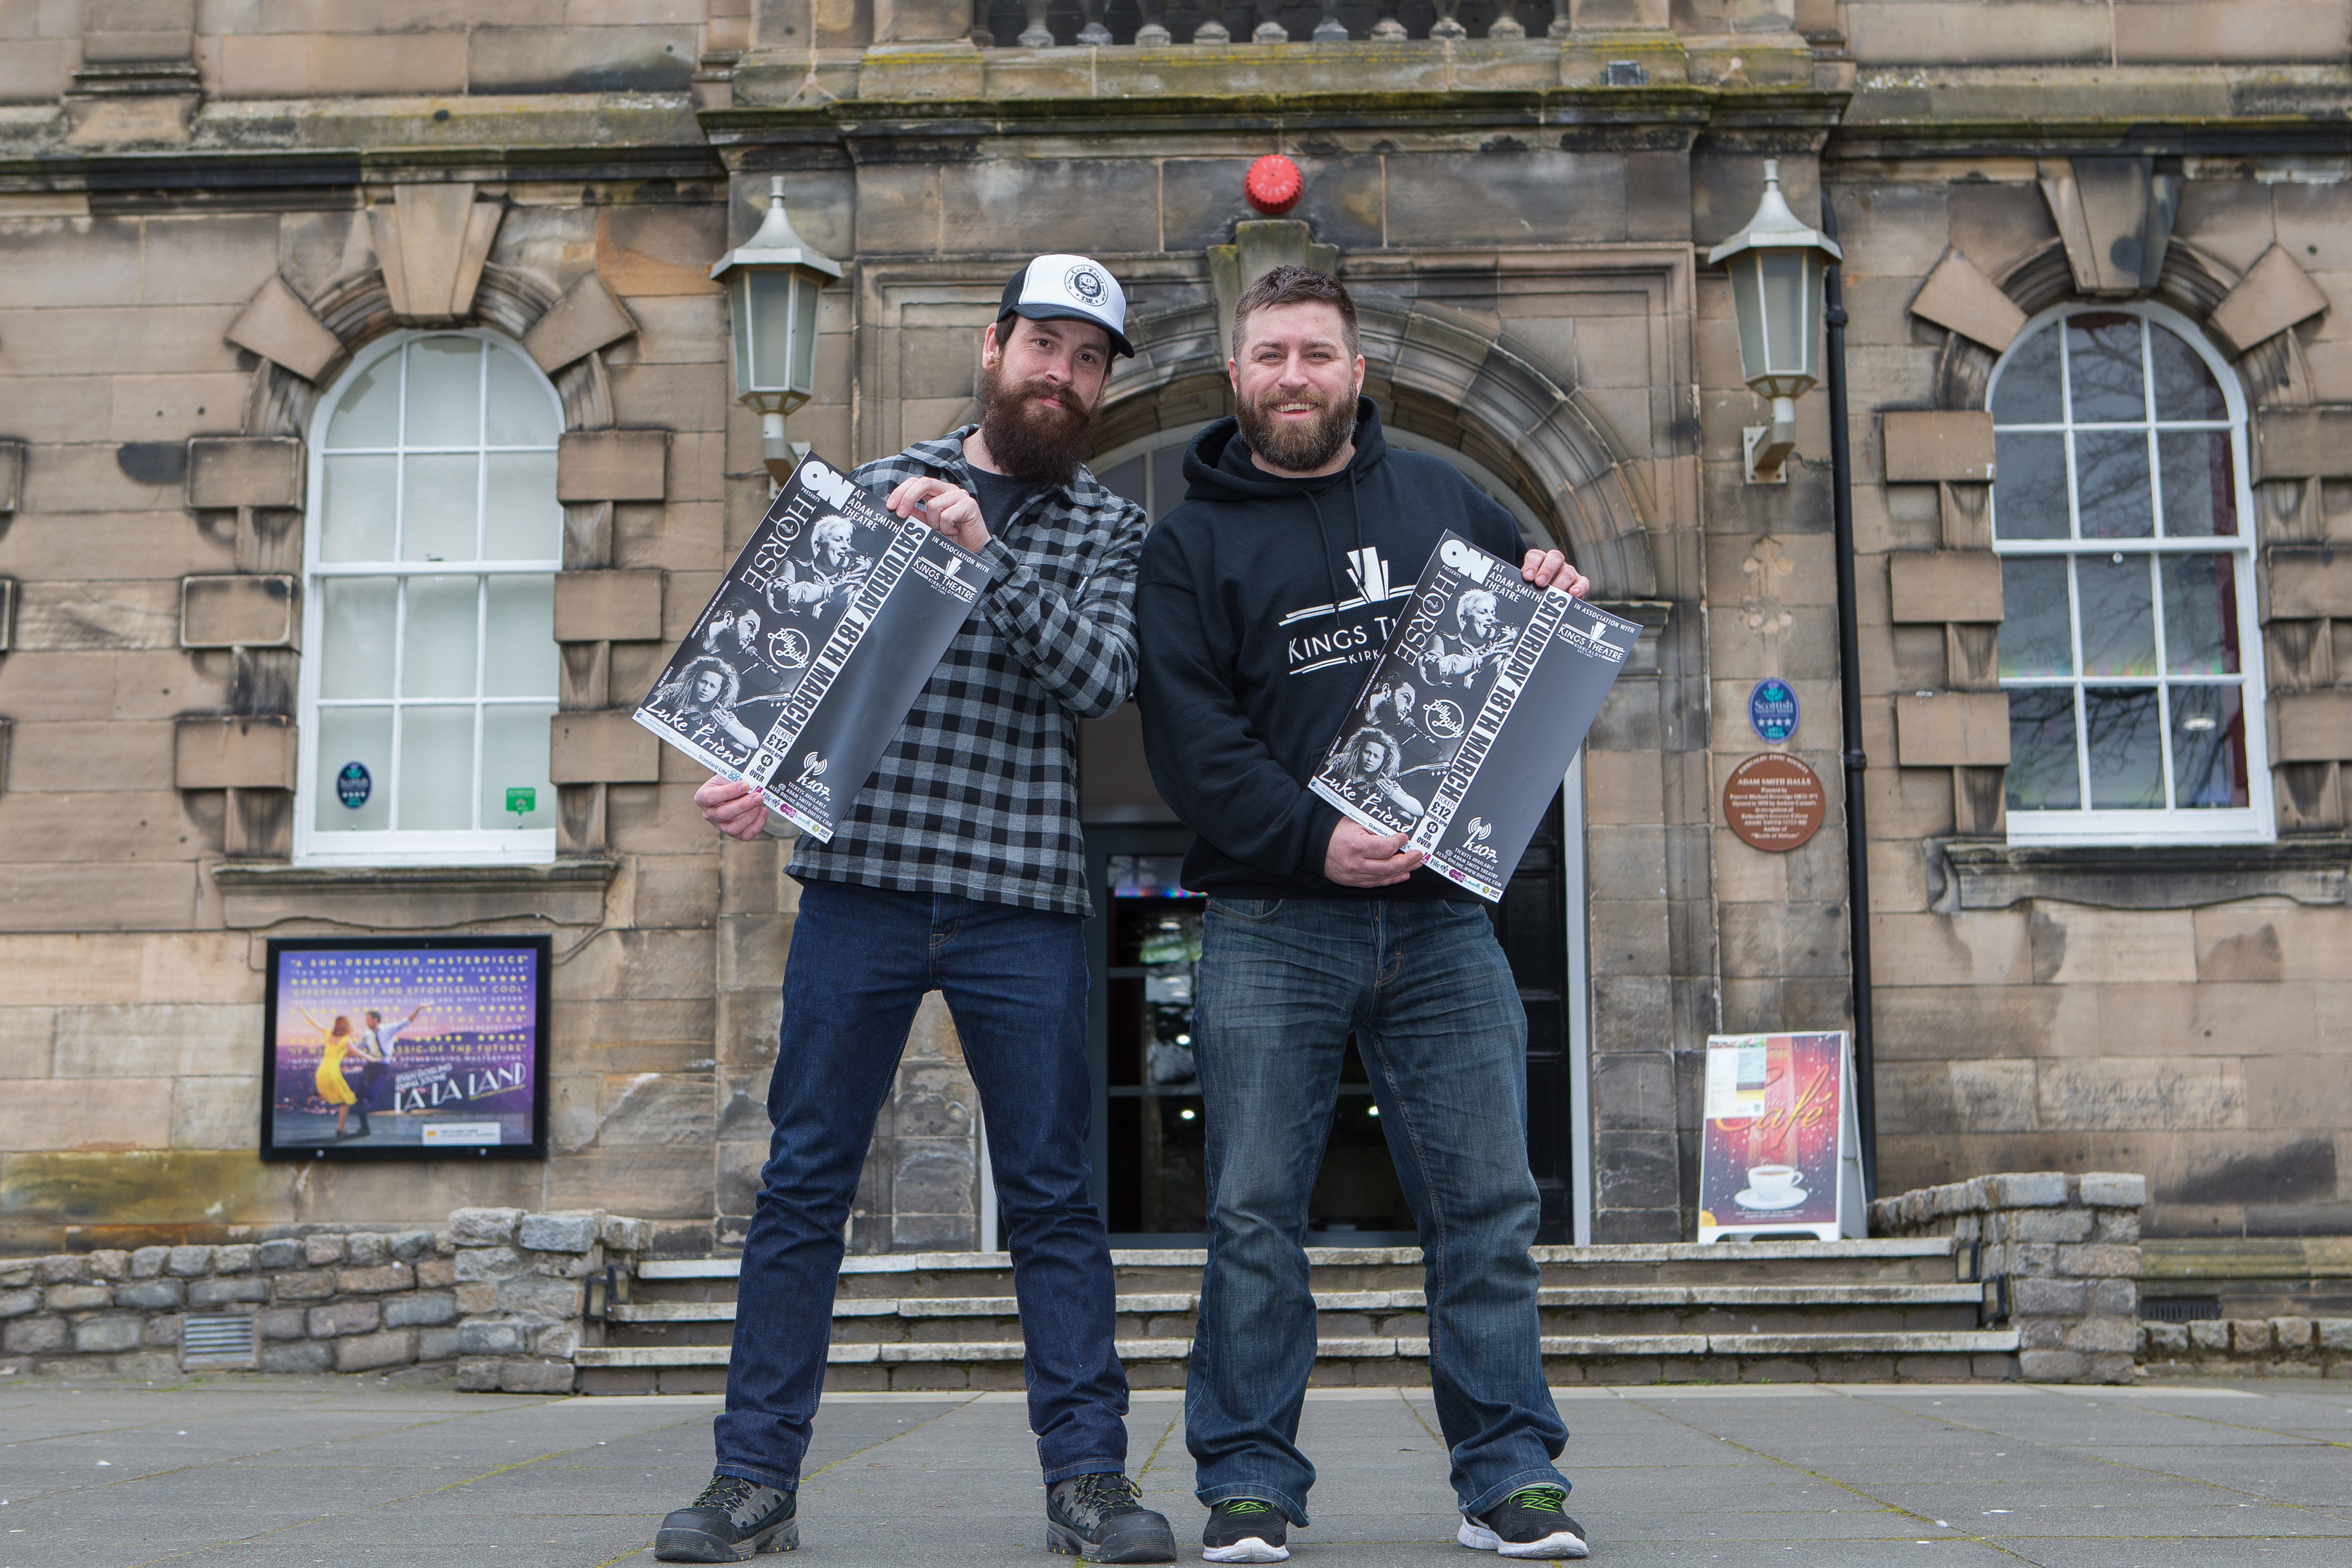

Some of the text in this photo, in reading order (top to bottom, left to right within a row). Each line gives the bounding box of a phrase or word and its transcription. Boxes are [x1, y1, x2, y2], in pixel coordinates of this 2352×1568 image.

[799, 460, 857, 511] ON
[800, 486, 822, 503] PRESENTS
[852, 489, 867, 500] AT
[841, 504, 879, 532] THEATRE
[846, 497, 901, 534] ADAM SMITH
[738, 491, 819, 594] HORSE
[931, 535, 990, 573] IN ASSOCIATION WITH
[1439, 539, 1495, 585] ON
[1441, 563, 1463, 579] PRESENTS
[1492, 563, 1506, 573] AT
[912, 558, 976, 603] KINGS THEATRE
[927, 577, 955, 596] KIRKCALDY
[1484, 578, 1521, 603] THEATRE
[1487, 571, 1543, 603] ADAM SMITH
[776, 520, 926, 737] SATURDAY 18TH MARCH
[1392, 569, 1461, 667] HORSE
[1572, 602, 1636, 634] IN ASSOCIATION WITH
[767, 627, 796, 651] Billy
[1289, 625, 1367, 663] KINGS
[1557, 624, 1624, 663] KINGS THEATRE
[1573, 640, 1603, 658] KIRKCALDY
[775, 644, 809, 669] Bibby
[1438, 588, 1568, 804] SATURDAY 18TH MARCH
[1755, 699, 1793, 710] Scottish
[1422, 698, 1451, 719] Billy
[645, 695, 750, 766] Luke Friend
[772, 724, 795, 743] TICKETS
[1432, 716, 1465, 739] Bibby
[759, 743, 775, 756] DOORS
[765, 732, 788, 754] £12
[697, 753, 719, 770] Standard
[716, 766, 728, 776] Life
[756, 764, 766, 775] OR
[760, 755, 772, 767] 14
[748, 768, 765, 783] OVER
[767, 783, 781, 794] ALSO
[787, 780, 828, 809] TICKETS AVAILABLE
[1318, 765, 1417, 833] Luke Friend
[776, 782, 830, 819] @ ADAM SMITH THEATRE
[1429, 801, 1452, 820] £12
[1435, 793, 1457, 810] TICKETS
[1424, 810, 1440, 822] DOORS
[1426, 822, 1437, 833] 14
[1366, 821, 1389, 838] Standard
[1422, 831, 1432, 841] OR
[1416, 836, 1432, 850] OVER
[1429, 857, 1442, 869] Fife
[1435, 850, 1449, 860] ALSO
[1444, 849, 1499, 881] @ ADAM SMITH THEATRE
[1454, 846, 1495, 873] TICKETS AVAILABLE
[310, 956, 420, 968] SUN-DRENCHED
[394, 1088, 426, 1114] LA
[431, 1078, 462, 1106] LA
[468, 1062, 526, 1097] LAND
